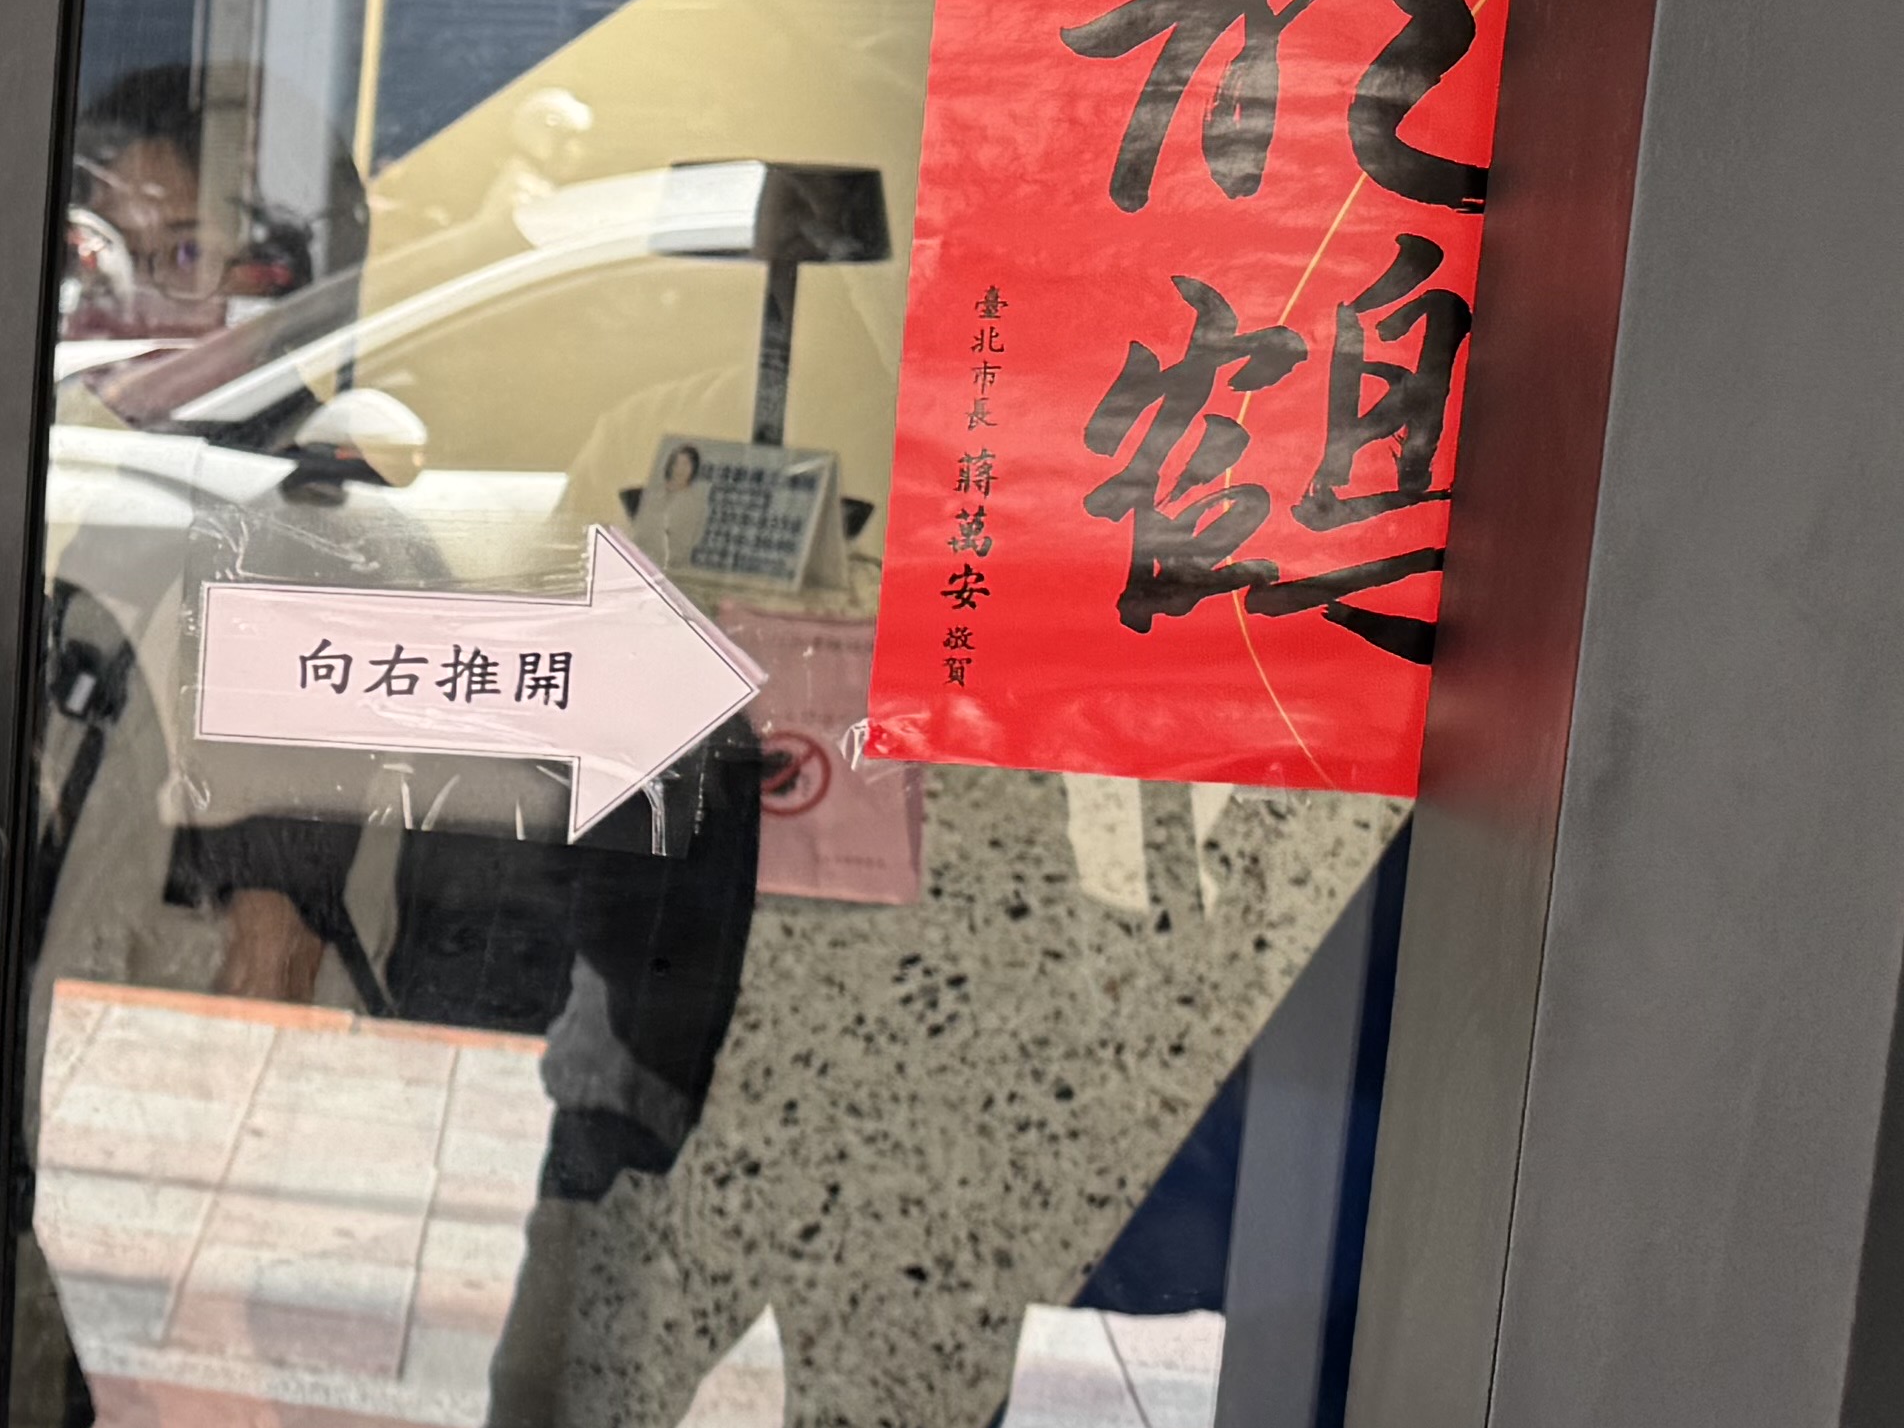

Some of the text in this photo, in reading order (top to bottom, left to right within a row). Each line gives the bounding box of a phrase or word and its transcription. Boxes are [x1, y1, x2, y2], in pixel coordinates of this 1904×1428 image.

[940, 285, 1009, 687] 臺北市長 蔣萬安 敬賀
[299, 638, 573, 710] 向右推開
